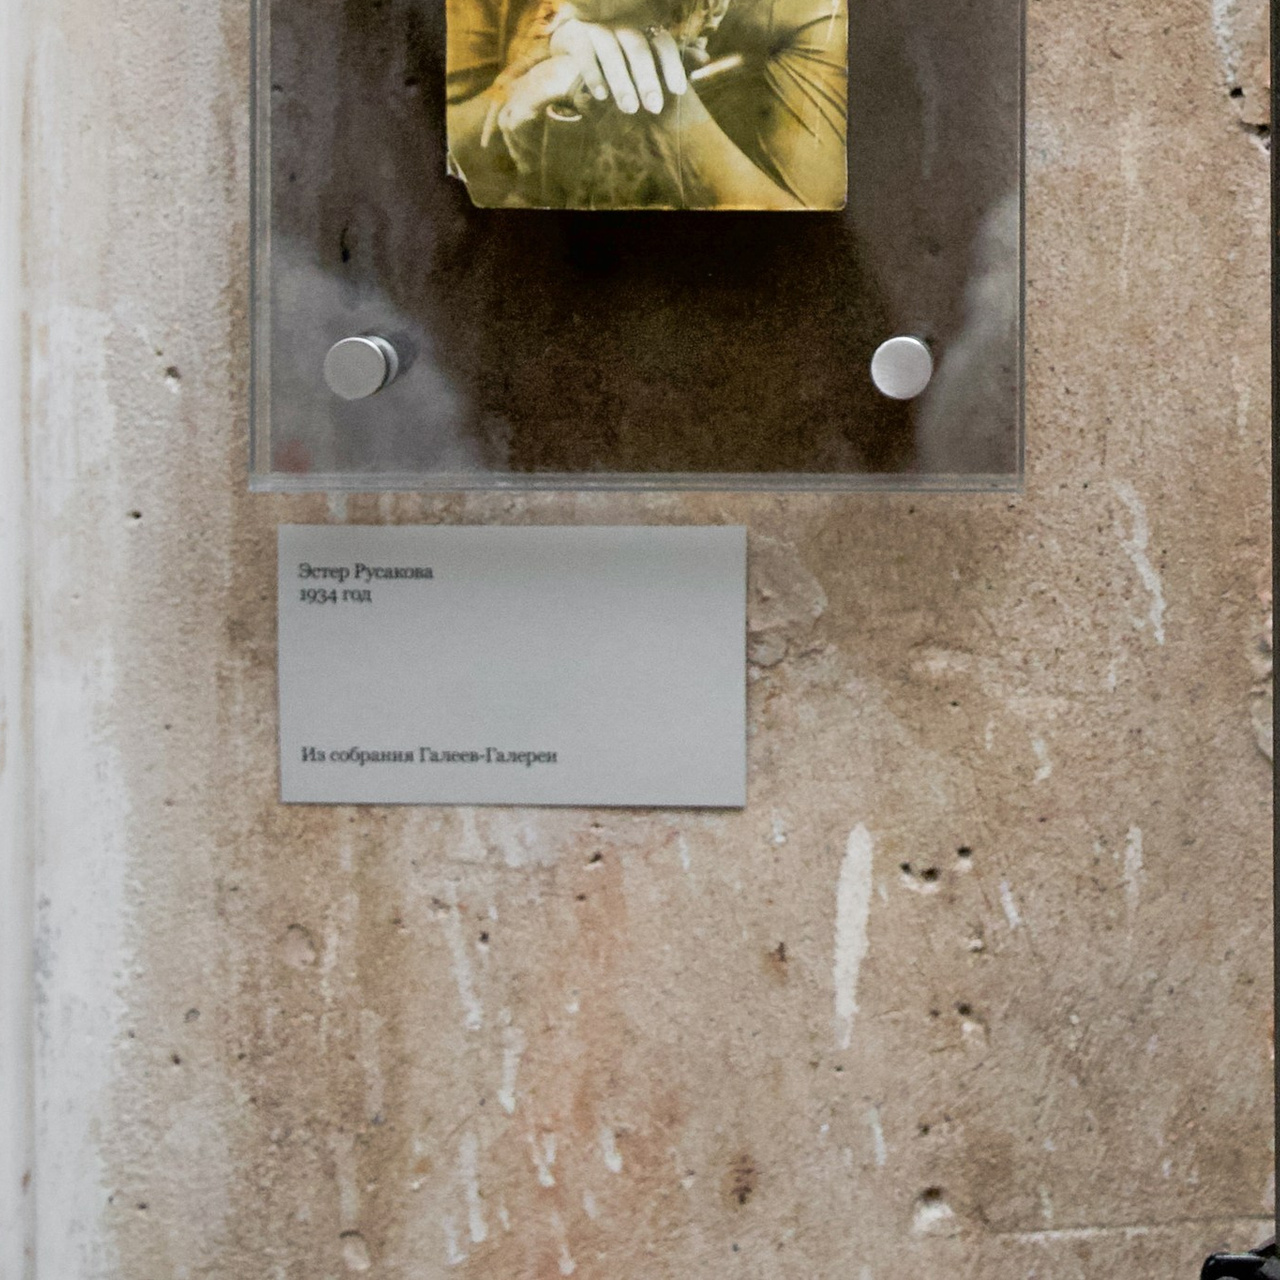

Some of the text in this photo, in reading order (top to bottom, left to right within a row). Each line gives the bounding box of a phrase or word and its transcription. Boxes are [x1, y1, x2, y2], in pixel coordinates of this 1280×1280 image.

[298, 562, 434, 583] Эстер Русакова
[300, 587, 372, 605] 1934 год
[301, 746, 557, 768] Из собрания Галеев-Галереи
